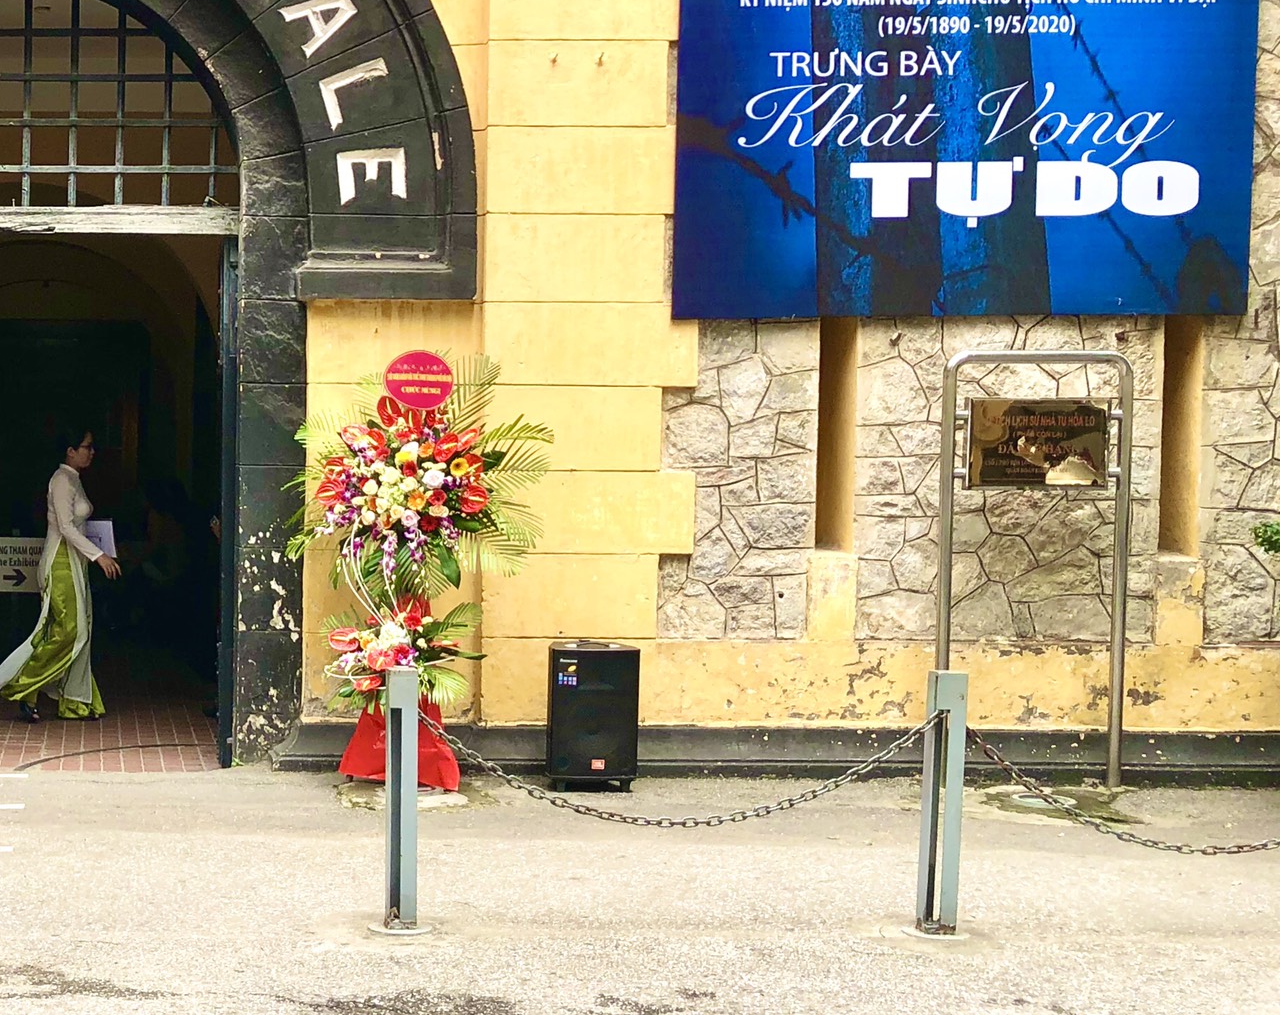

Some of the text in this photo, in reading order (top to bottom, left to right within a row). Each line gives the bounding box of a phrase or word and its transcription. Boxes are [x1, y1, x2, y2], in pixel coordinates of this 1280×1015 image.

[878, 15, 971, 38] (19/5/1890
[984, 14, 1076, 36] 19/5/2020)
[769, 45, 963, 77] TRƯNG BÀY
[738, 82, 1176, 169] Khát Vọng
[849, 156, 1201, 228] TỰ DO
[9, 545, 28, 555] THAM
[29, 545, 44, 556] QUA
